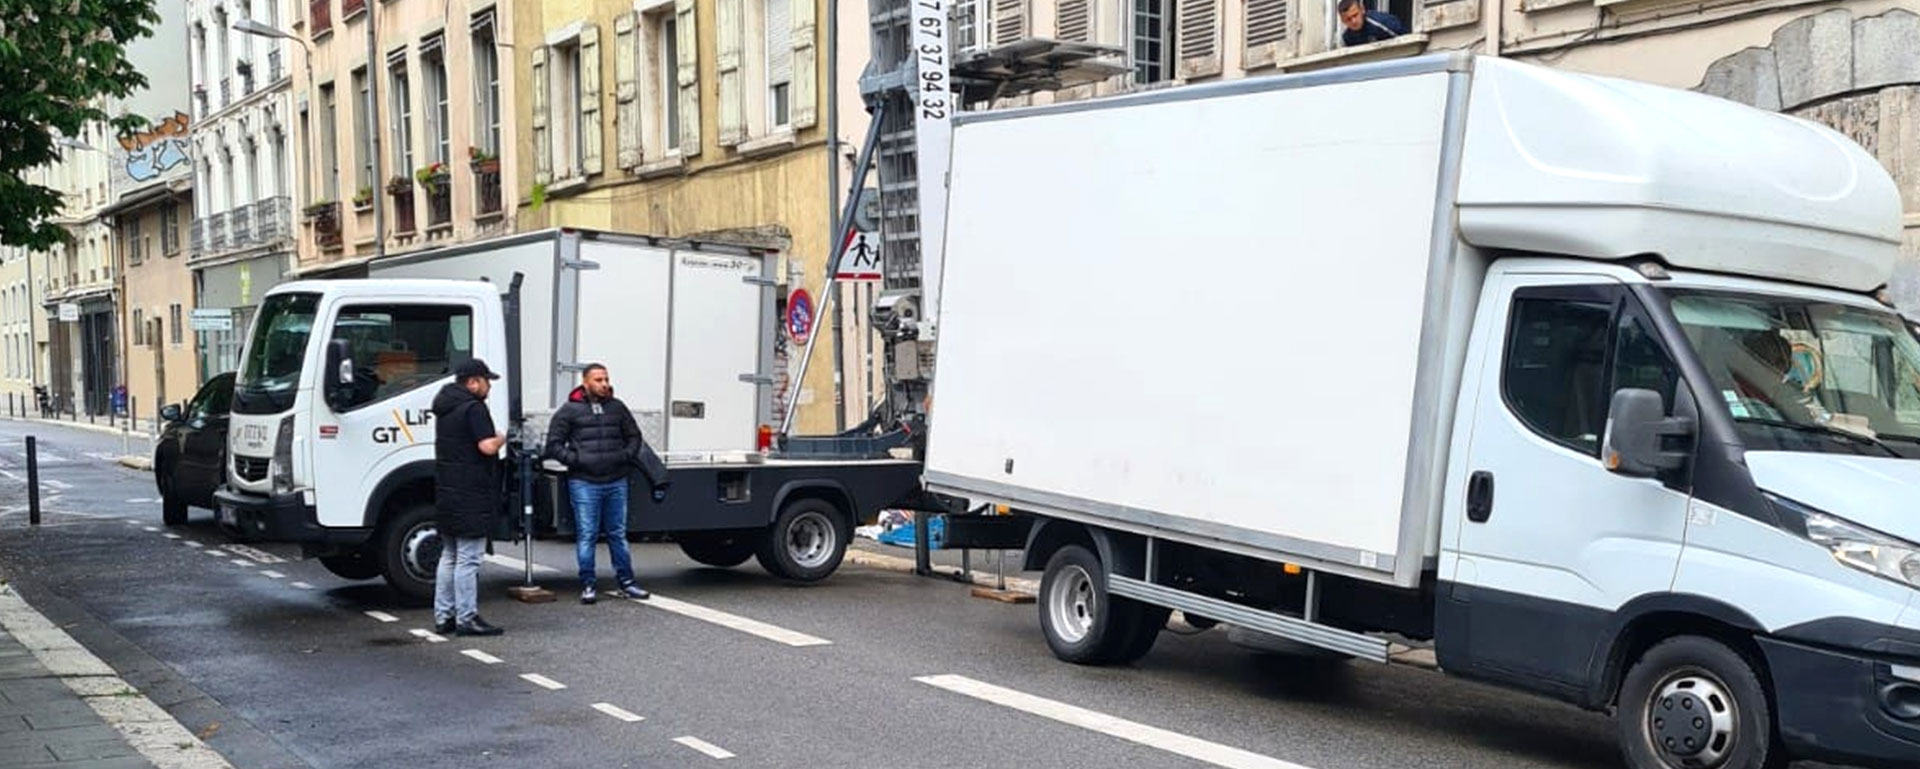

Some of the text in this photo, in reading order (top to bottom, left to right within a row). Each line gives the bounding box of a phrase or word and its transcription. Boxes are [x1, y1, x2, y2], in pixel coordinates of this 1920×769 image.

[920, 17, 941, 38] 67
[920, 44, 942, 65] 37
[922, 71, 943, 92] 94
[923, 99, 945, 119] 32
[372, 427, 401, 443] GT
